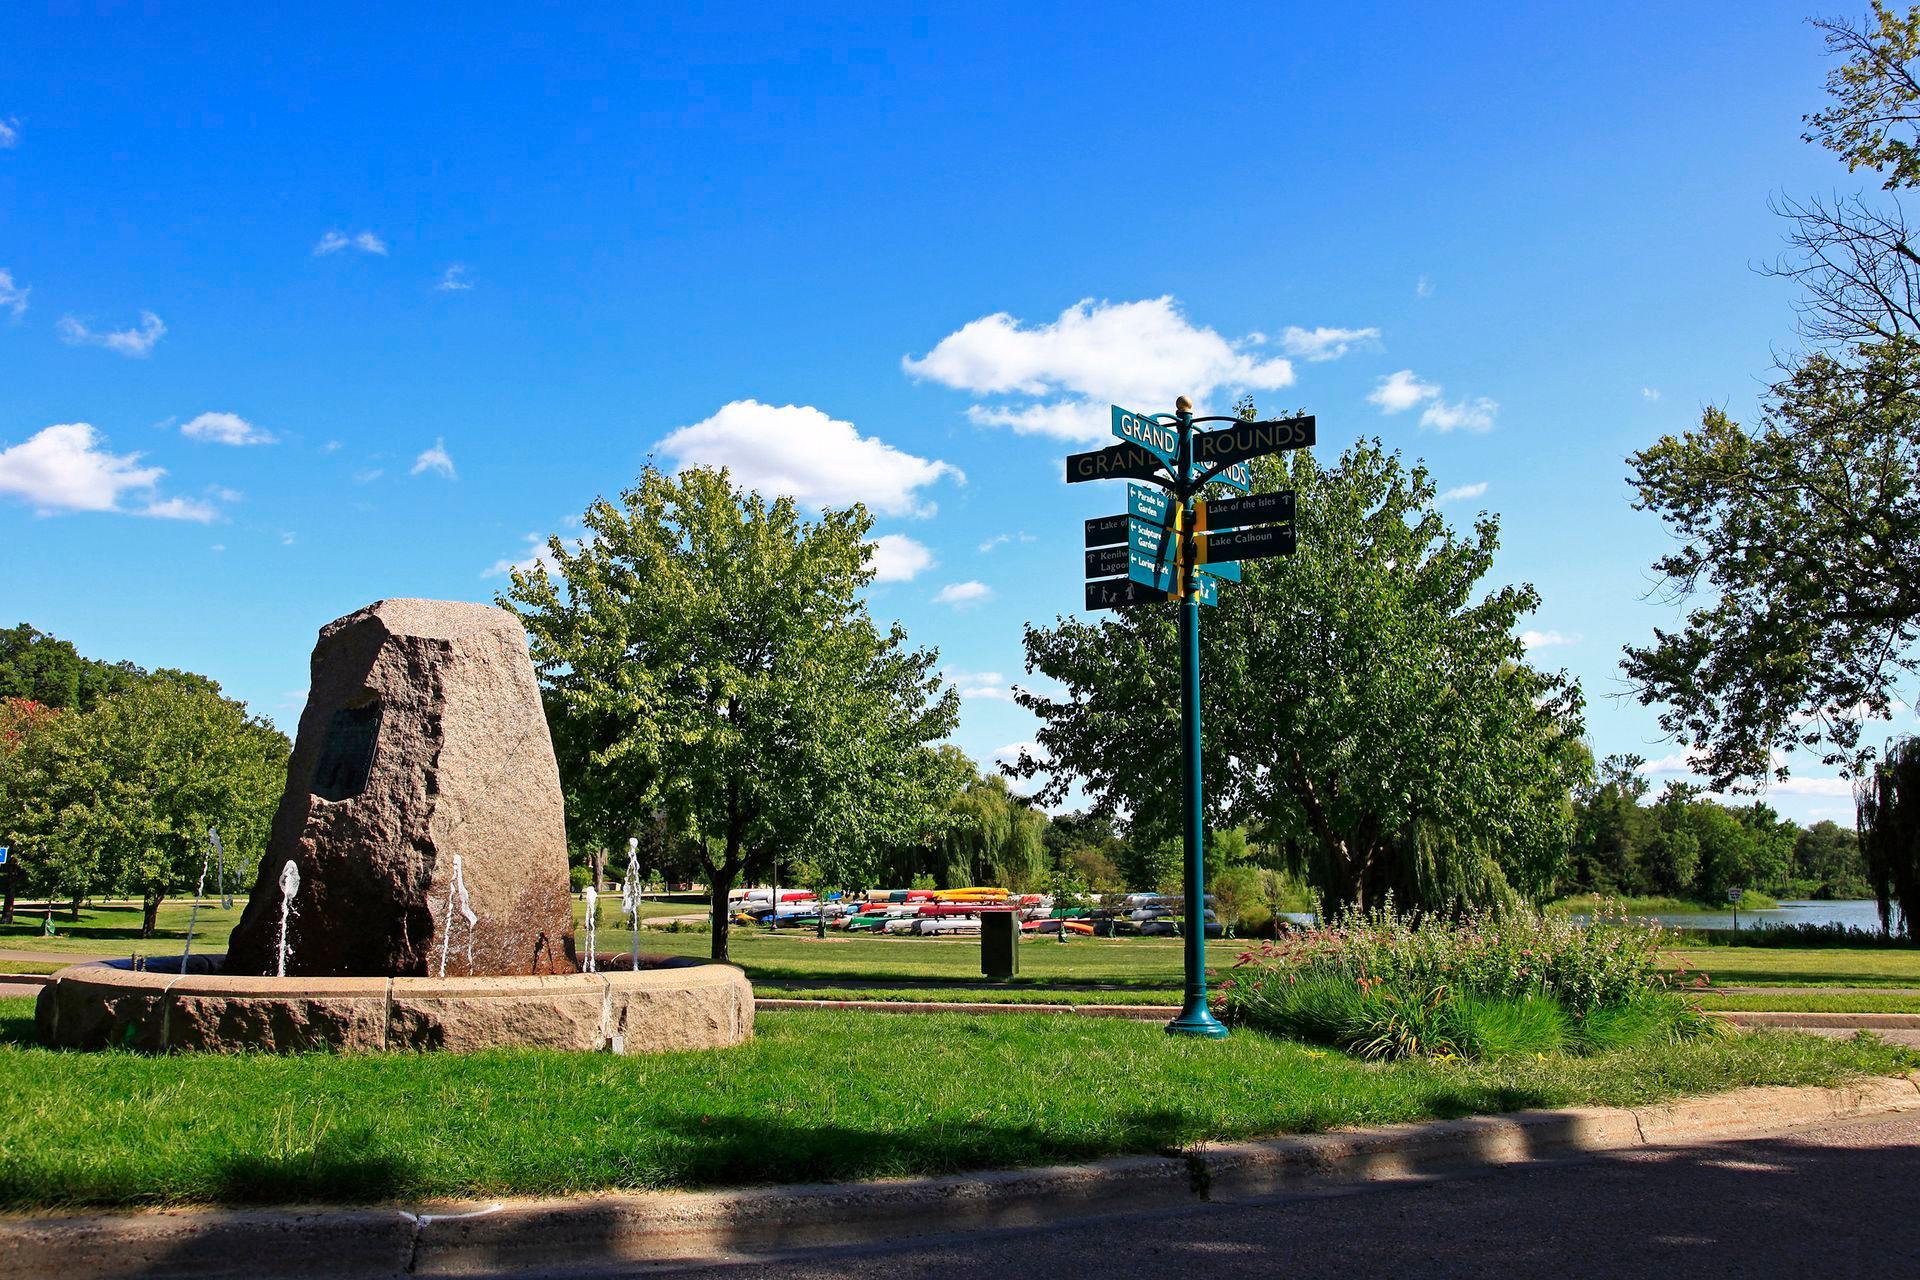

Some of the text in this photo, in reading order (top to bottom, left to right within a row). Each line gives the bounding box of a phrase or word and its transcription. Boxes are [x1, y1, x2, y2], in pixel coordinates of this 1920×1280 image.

[1121, 414, 1175, 453] GRAND
[1202, 422, 1306, 457] ROUNDS
[1137, 489, 1165, 508] Parade Ice
[1208, 504, 1228, 514] Lake
[1230, 501, 1240, 510] of
[1242, 498, 1257, 509] the
[1137, 502, 1158, 517] Garden
[1100, 521, 1118, 530] Lake
[1137, 525, 1162, 541] Sculpture
[1137, 537, 1158, 550] Garden
[1209, 532, 1273, 547] Lake Calhoun
[1100, 550, 1128, 560] Kenilw
[1138, 556, 1155, 573] Loring
